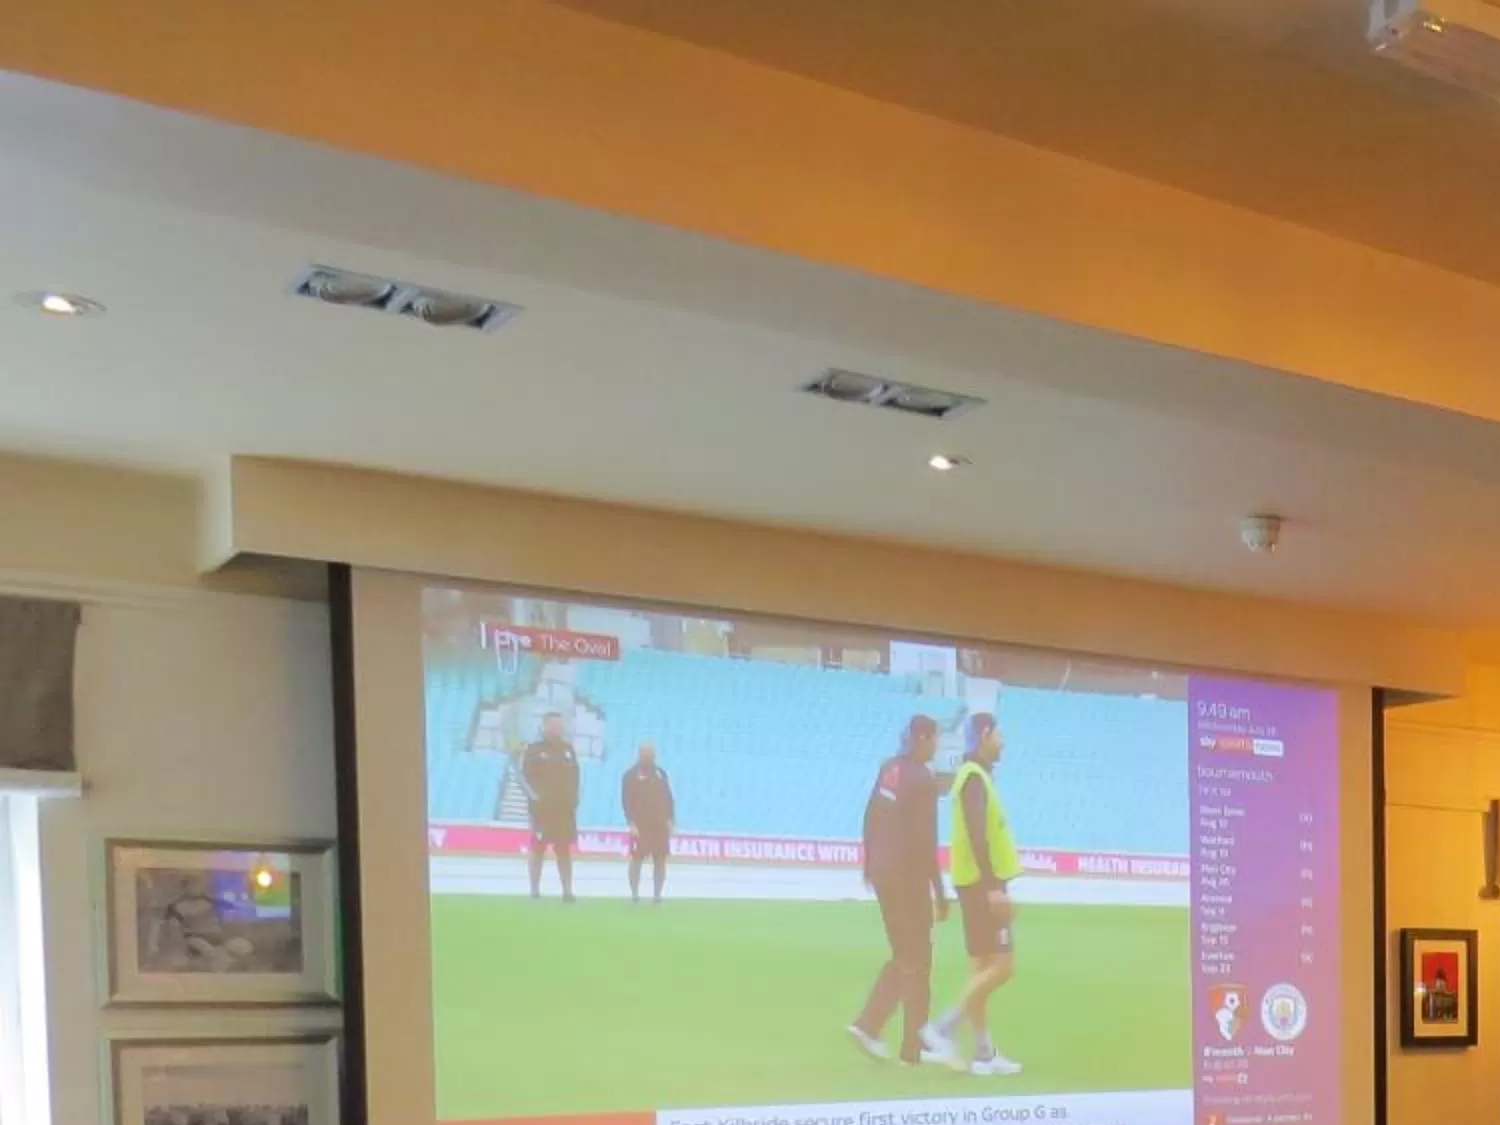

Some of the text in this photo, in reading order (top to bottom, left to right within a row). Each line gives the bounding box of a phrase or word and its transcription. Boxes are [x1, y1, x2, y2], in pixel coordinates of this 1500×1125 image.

[574, 637, 612, 656] Oval
[669, 837, 720, 857] EALTH
[723, 840, 816, 862] INSURANCE
[963, 1107, 977, 1123] in
[981, 1106, 1030, 1124] Group
[1033, 1105, 1046, 1120] G
[1051, 1107, 1067, 1119] as
